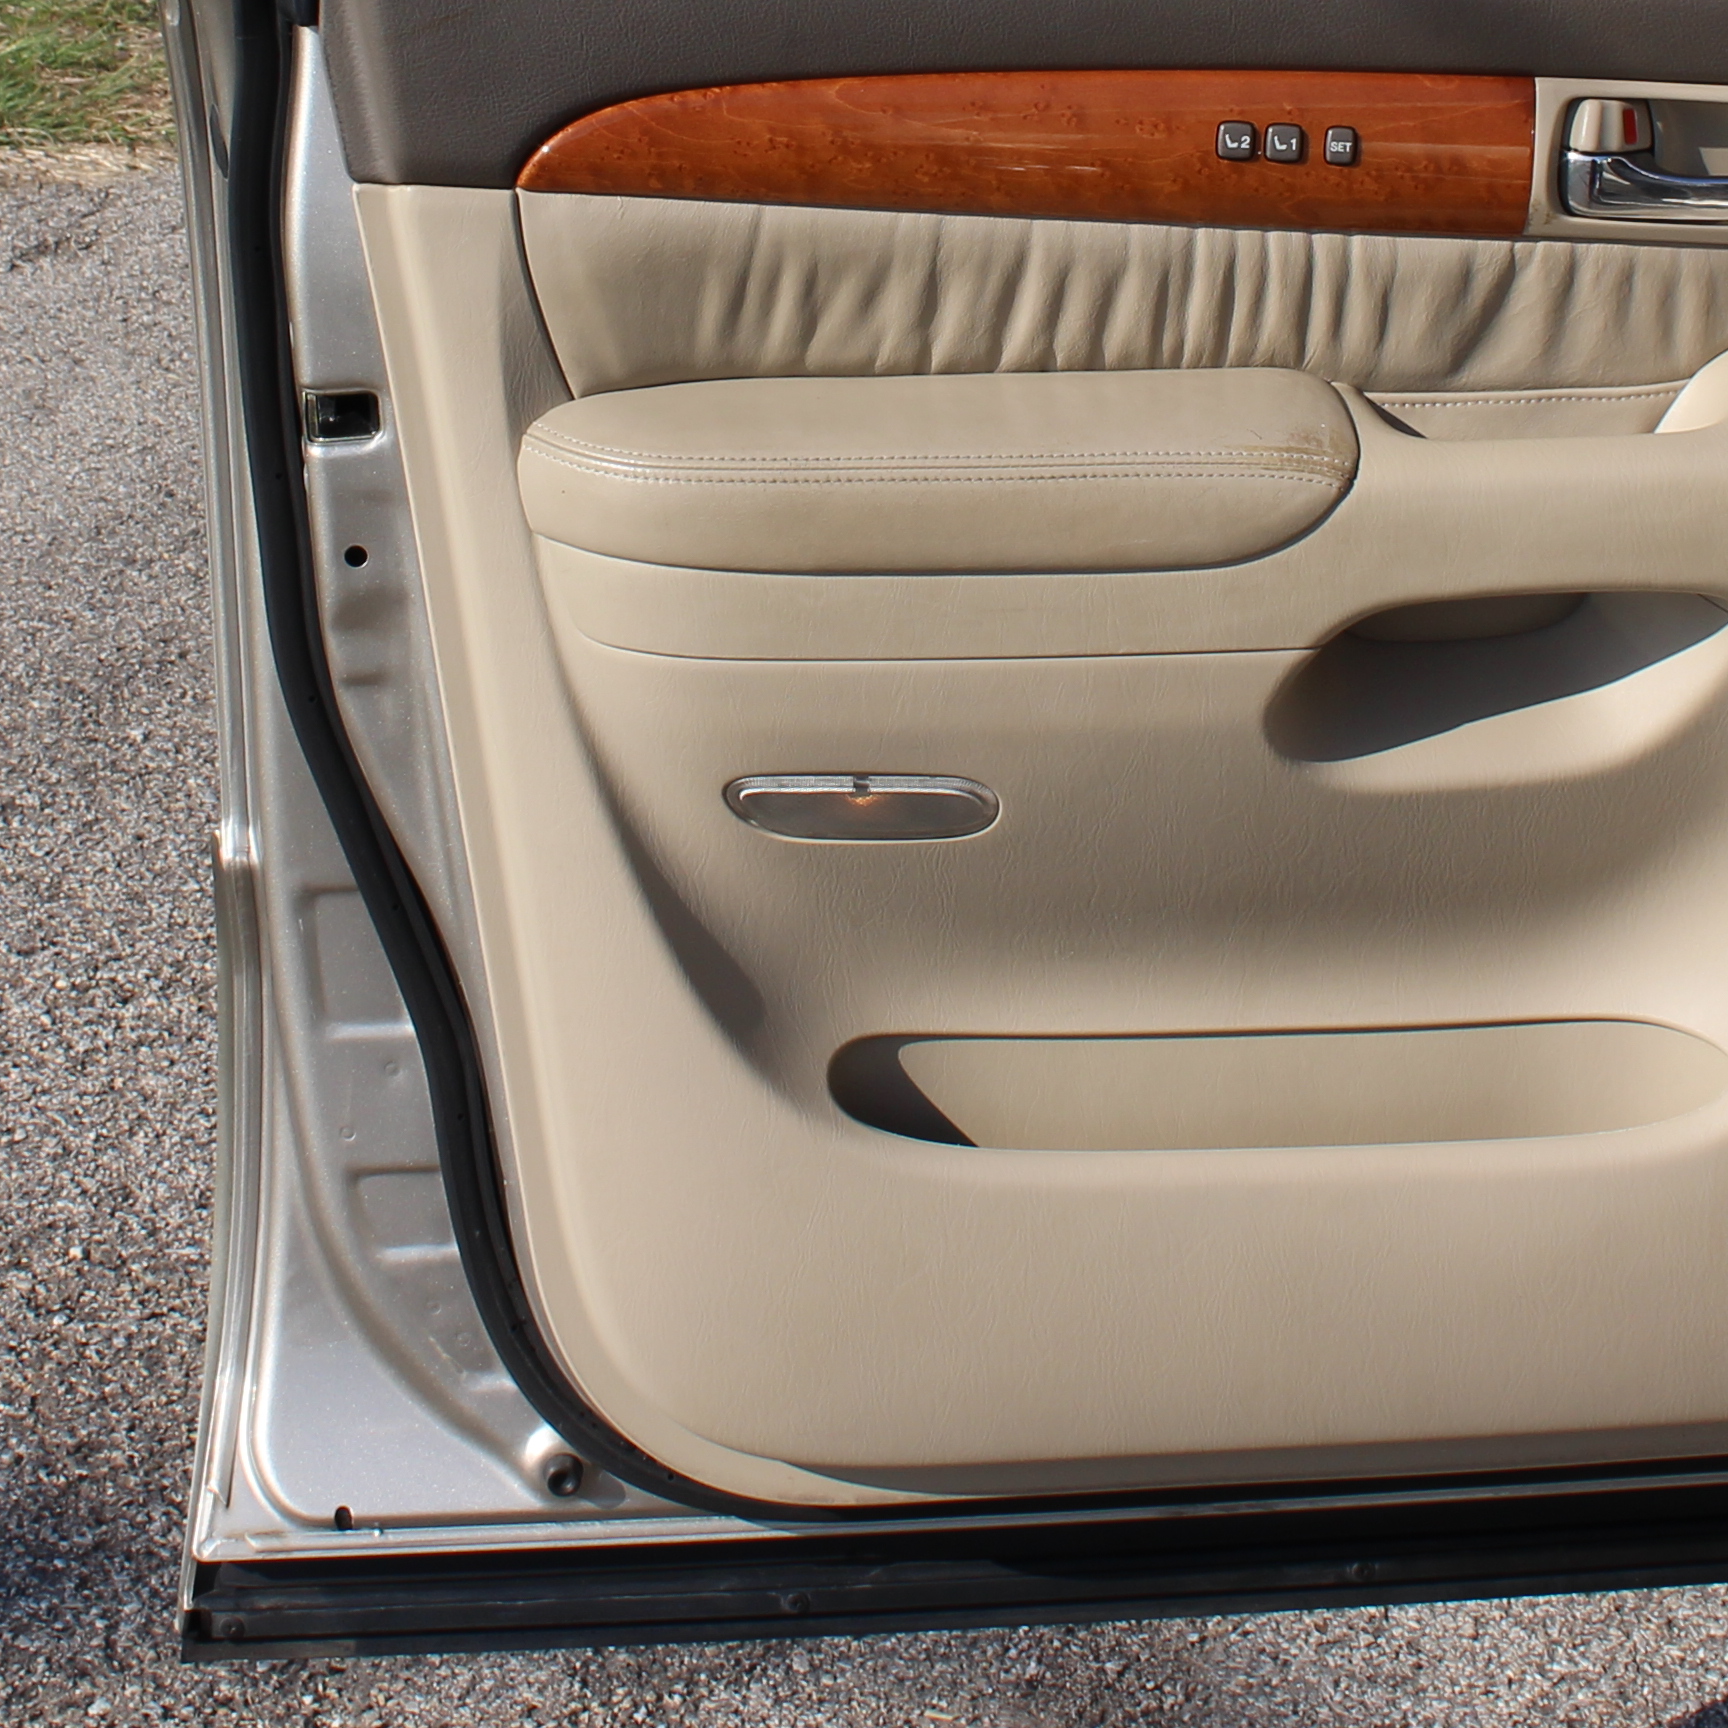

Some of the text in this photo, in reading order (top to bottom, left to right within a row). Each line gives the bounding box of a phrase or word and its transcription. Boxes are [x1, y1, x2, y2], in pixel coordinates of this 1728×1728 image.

[1241, 135, 1251, 149] 2
[1290, 137, 1297, 151] 1
[1330, 141, 1353, 153] SET
